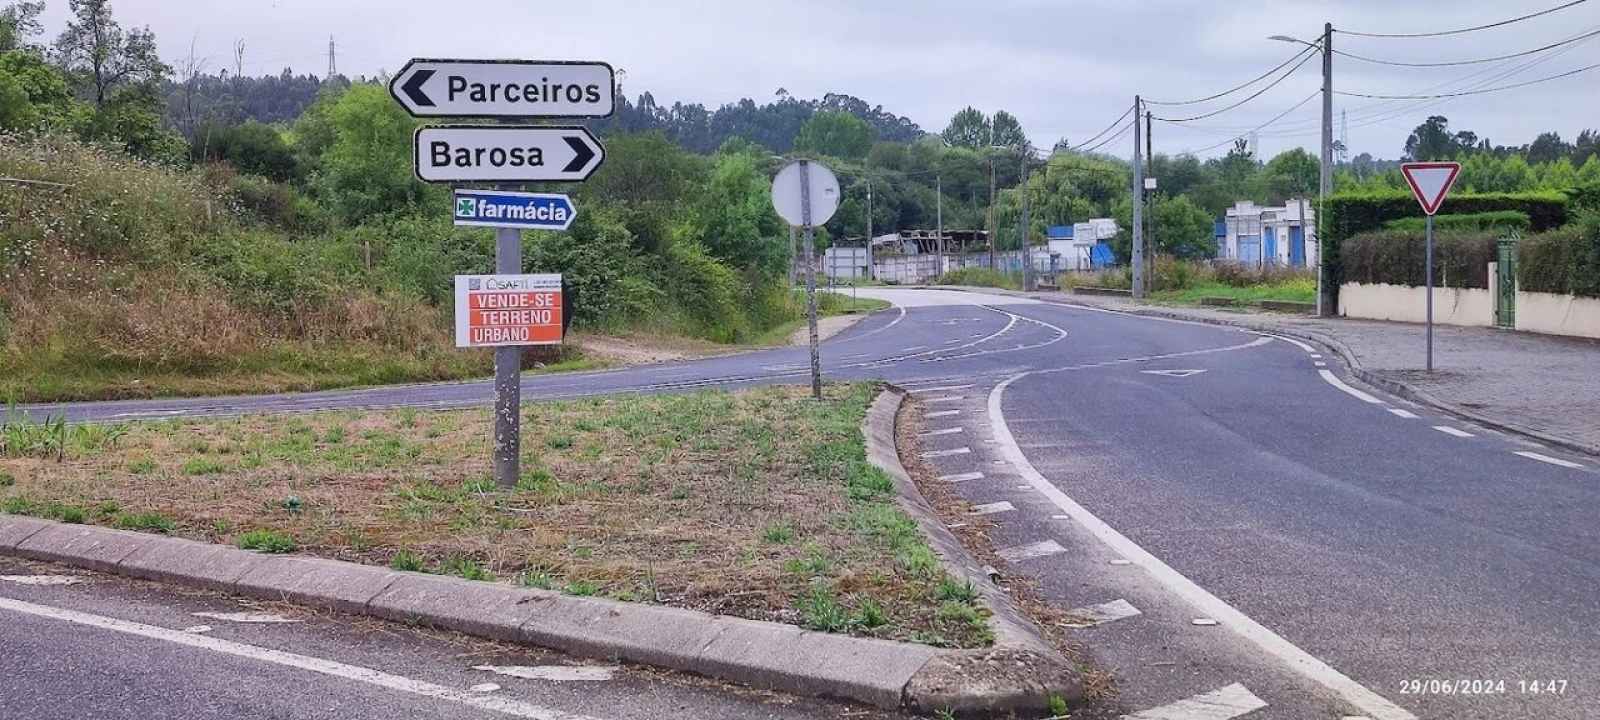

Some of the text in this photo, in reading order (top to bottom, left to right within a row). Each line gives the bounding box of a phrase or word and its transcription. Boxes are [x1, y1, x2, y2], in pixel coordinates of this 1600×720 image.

[448, 75, 601, 104] Parceiros
[430, 141, 544, 167] Barosa
[478, 199, 567, 221] farmácia
[477, 293, 554, 308] VENDE-SE
[480, 309, 551, 325] TERRENO
[474, 327, 529, 342] URBANO
